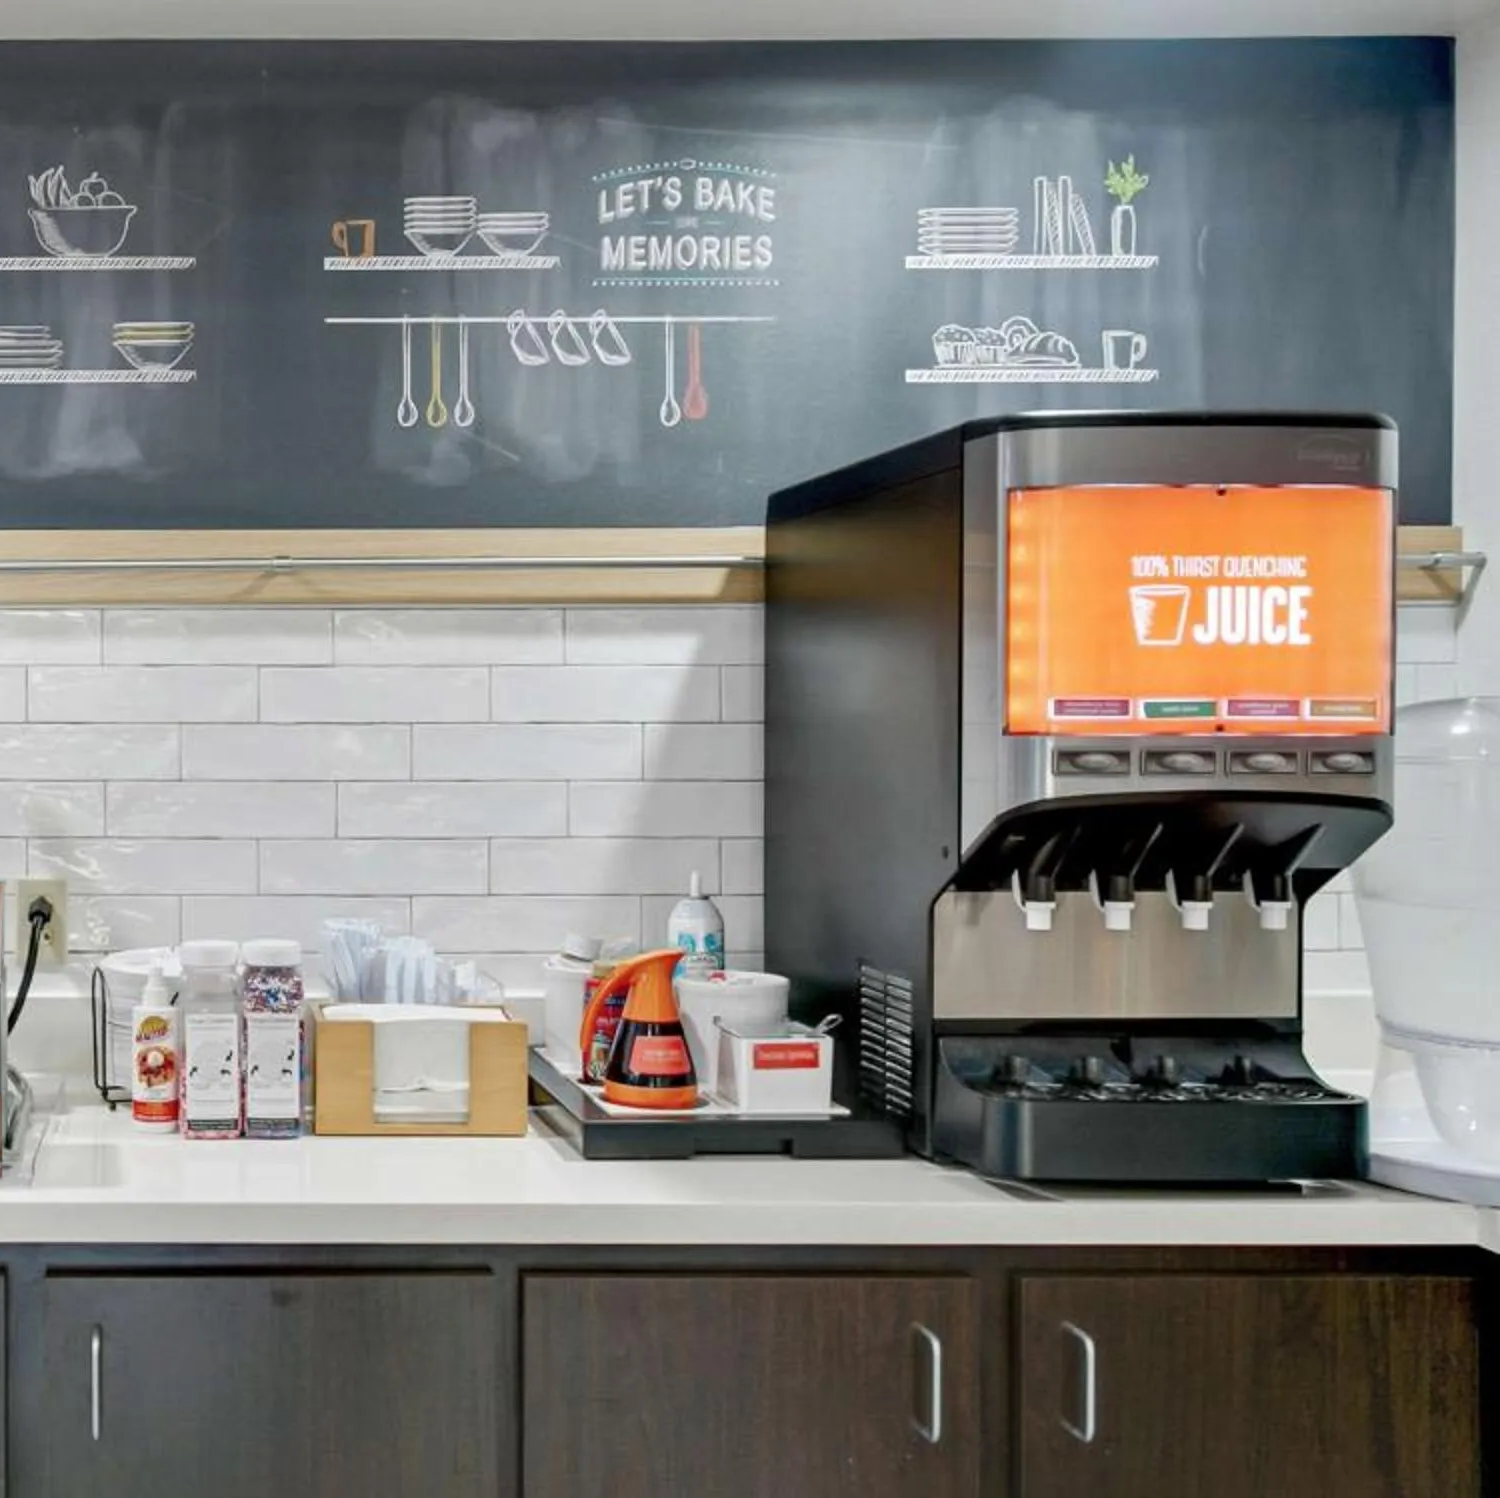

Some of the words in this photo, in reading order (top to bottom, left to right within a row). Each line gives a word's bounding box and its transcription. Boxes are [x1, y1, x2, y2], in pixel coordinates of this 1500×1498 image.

[598, 176, 683, 224] LET'S
[694, 177, 776, 222] BAKE
[601, 234, 774, 271] MEMORIES
[1131, 555, 1170, 578] 100%
[1172, 555, 1221, 578] THIRST
[1223, 555, 1308, 578] QUENCHING
[1192, 585, 1313, 645] JUICE
